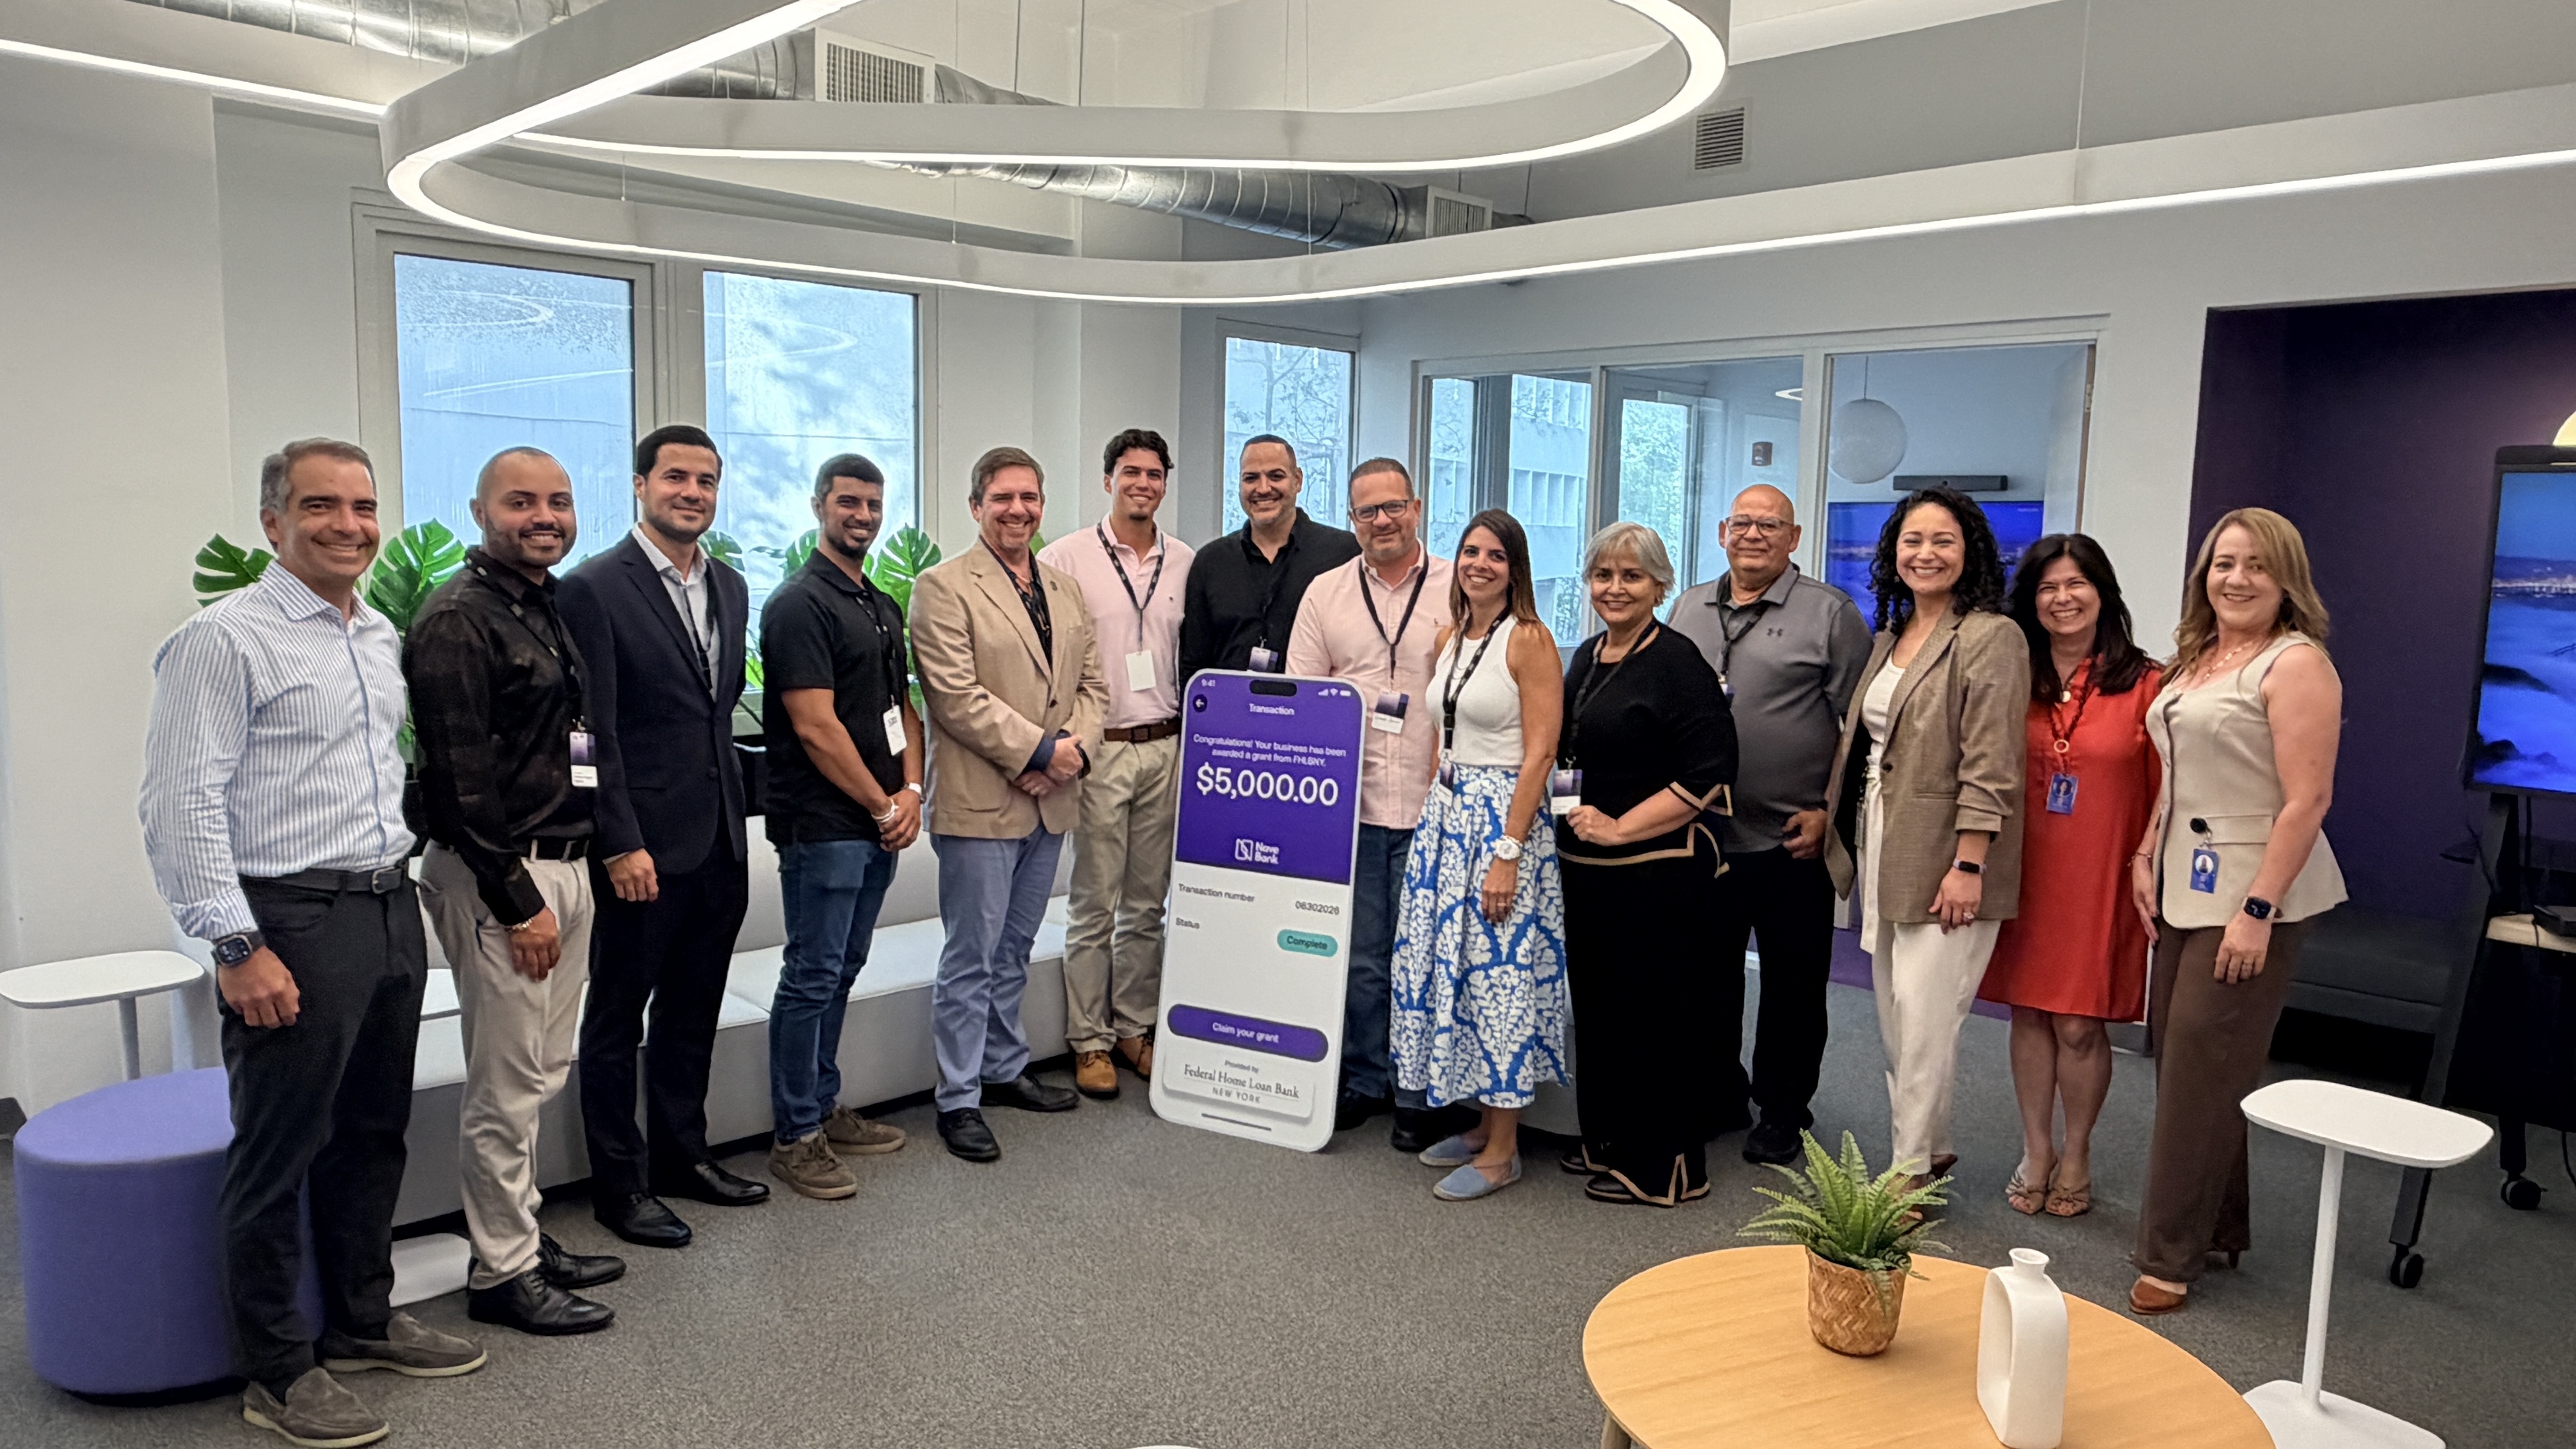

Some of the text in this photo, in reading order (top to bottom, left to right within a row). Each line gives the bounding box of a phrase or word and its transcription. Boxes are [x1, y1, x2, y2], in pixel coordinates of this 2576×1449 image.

[1249, 703, 1295, 716] Transaction
[1193, 734, 1346, 756] Congratulations! Your business has been
[1212, 749, 1245, 759] awarded
[1252, 752, 1272, 762] grant
[1273, 754, 1292, 763] from
[1196, 762, 1339, 806] $5,000.00
[1255, 851, 1279, 865] Bank
[1178, 883, 1255, 903] Transaction number
[1175, 917, 1200, 929] Status
[1286, 935, 1328, 950] Complete
[1212, 1021, 1279, 1044] Claim your grant
[1251, 1065, 1259, 1074] by
[1184, 1064, 1299, 1098] Federal Home Loan Bank
[1212, 1087, 1260, 1104] NEW YORK
